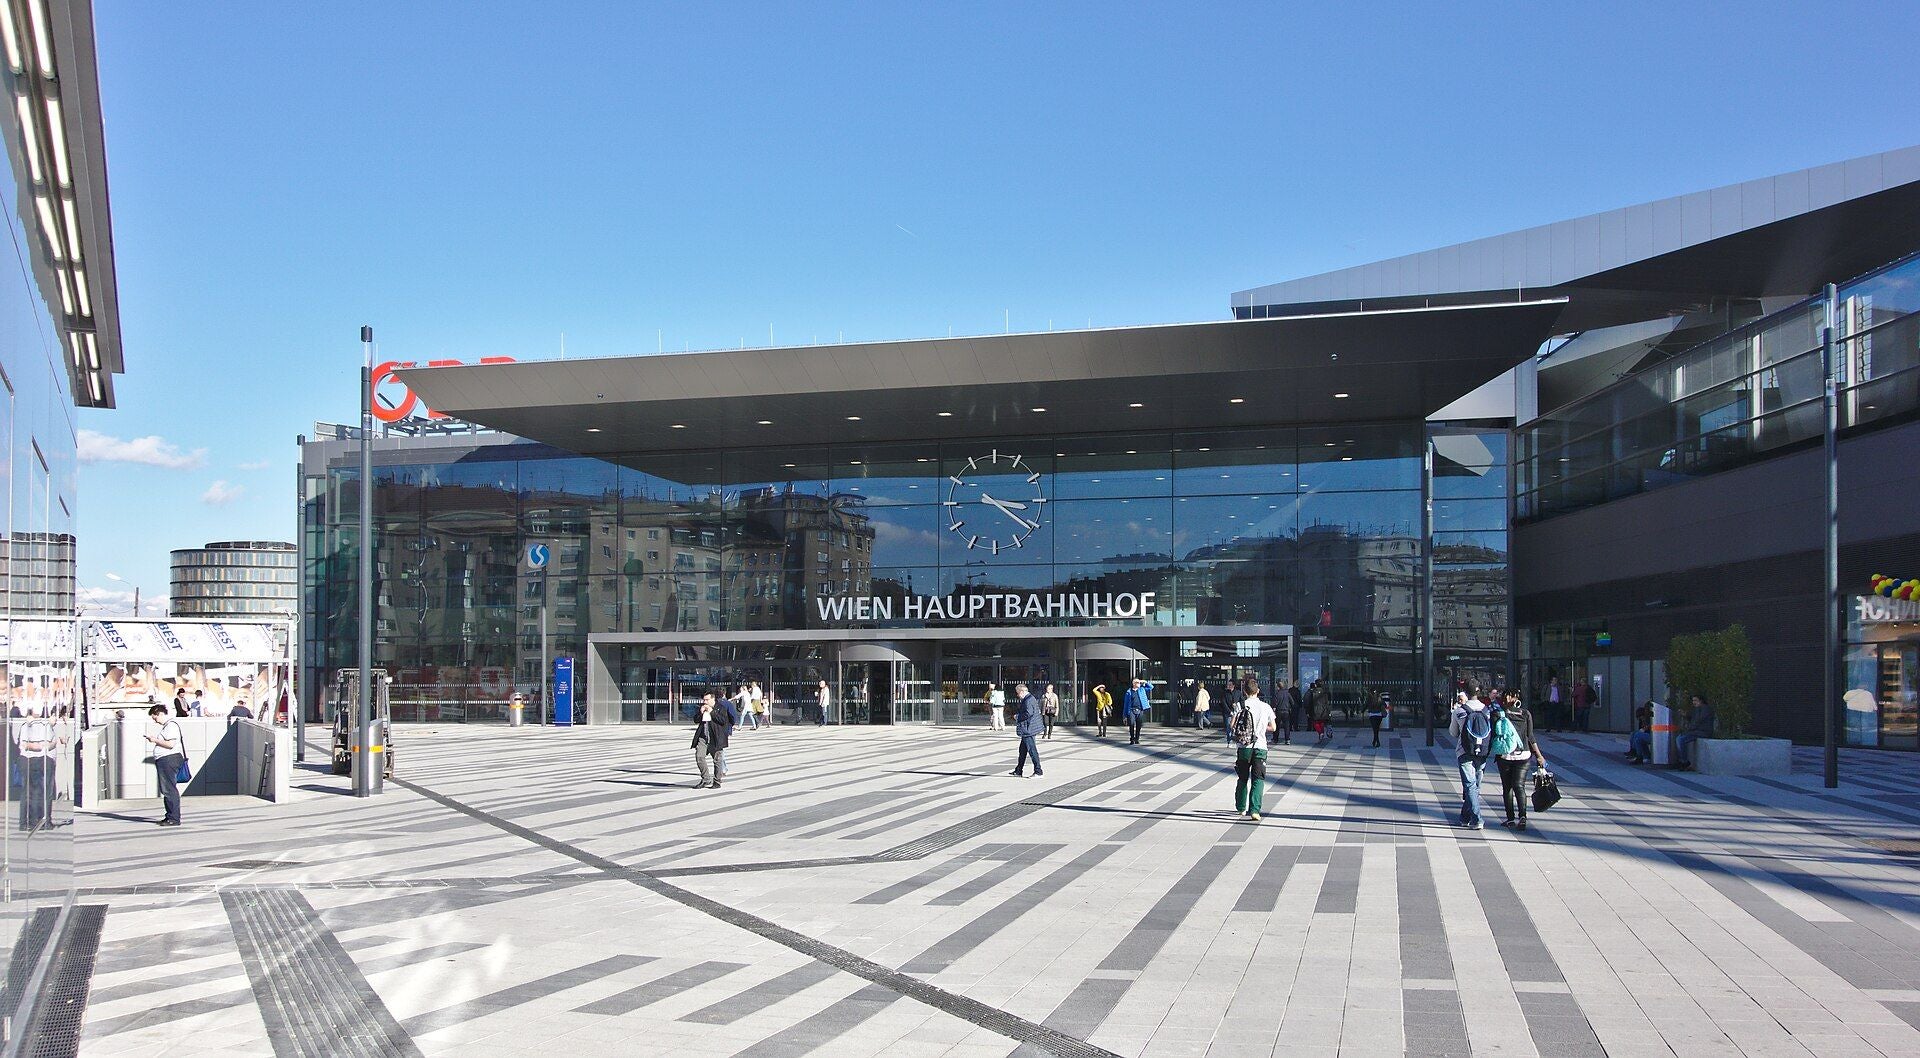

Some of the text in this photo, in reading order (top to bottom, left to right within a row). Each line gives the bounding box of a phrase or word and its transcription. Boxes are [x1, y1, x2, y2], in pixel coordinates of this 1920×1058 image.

[817, 592, 1155, 620] WIEN HAUPTBAHNHOF
[102, 622, 128, 649] BEST
[157, 623, 183, 650] BEST
[211, 624, 236, 650] BEST
